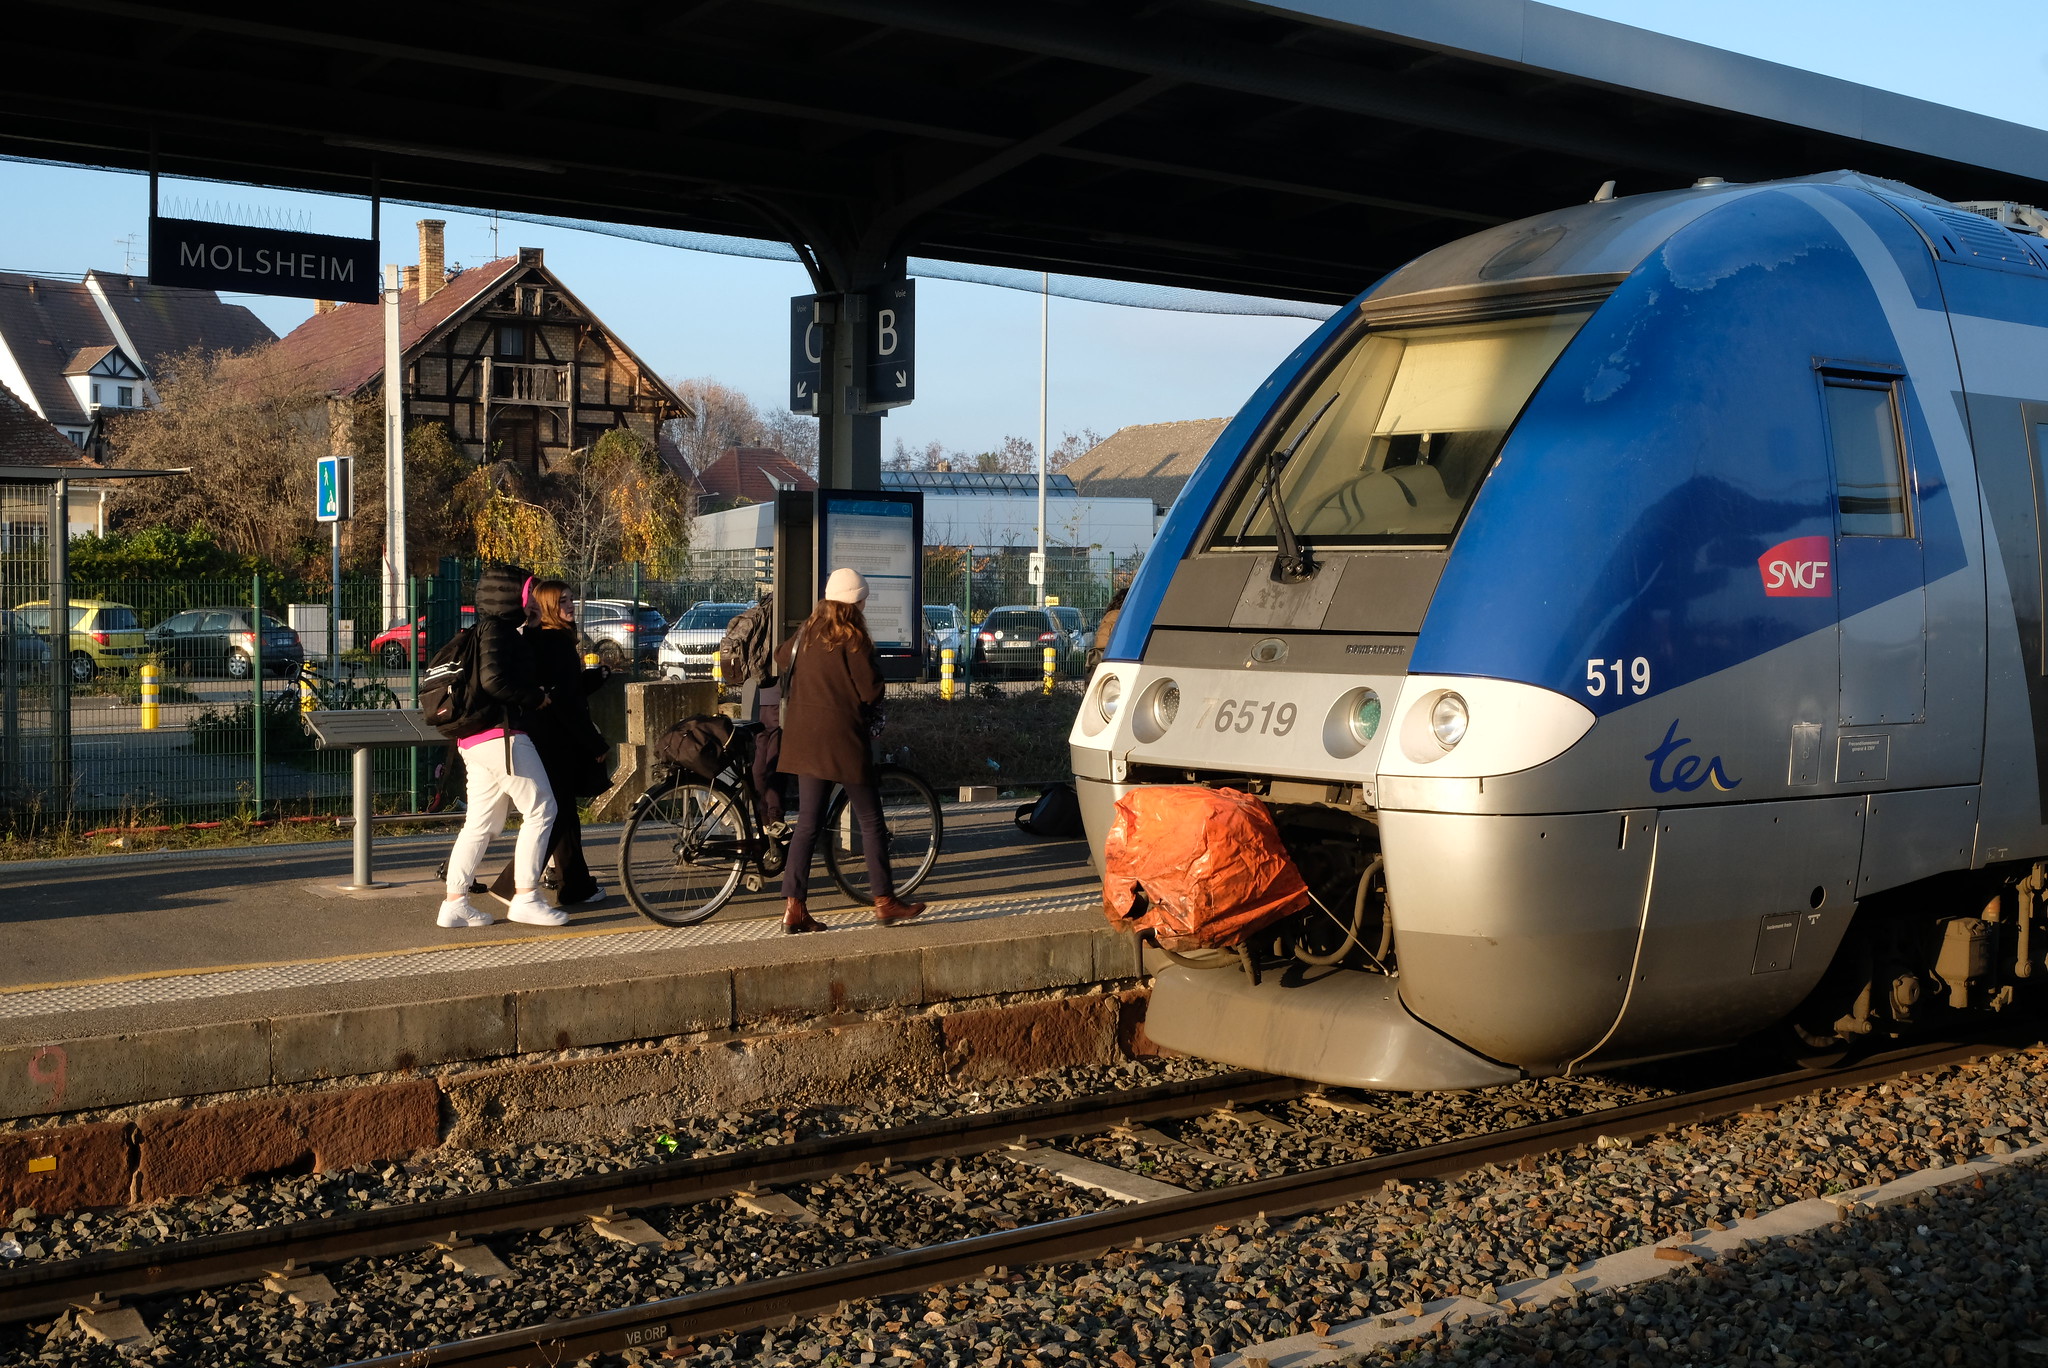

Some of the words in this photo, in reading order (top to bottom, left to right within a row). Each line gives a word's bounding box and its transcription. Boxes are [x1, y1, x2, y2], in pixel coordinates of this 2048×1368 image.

[180, 241, 354, 283] MOLSHEIM
[879, 309, 898, 356] B
[1767, 560, 1828, 589] SNCF
[1586, 656, 1650, 697] 519
[1644, 718, 1742, 793] ter
[626, 1331, 642, 1346] VB
[644, 1325, 667, 1342] ORP
